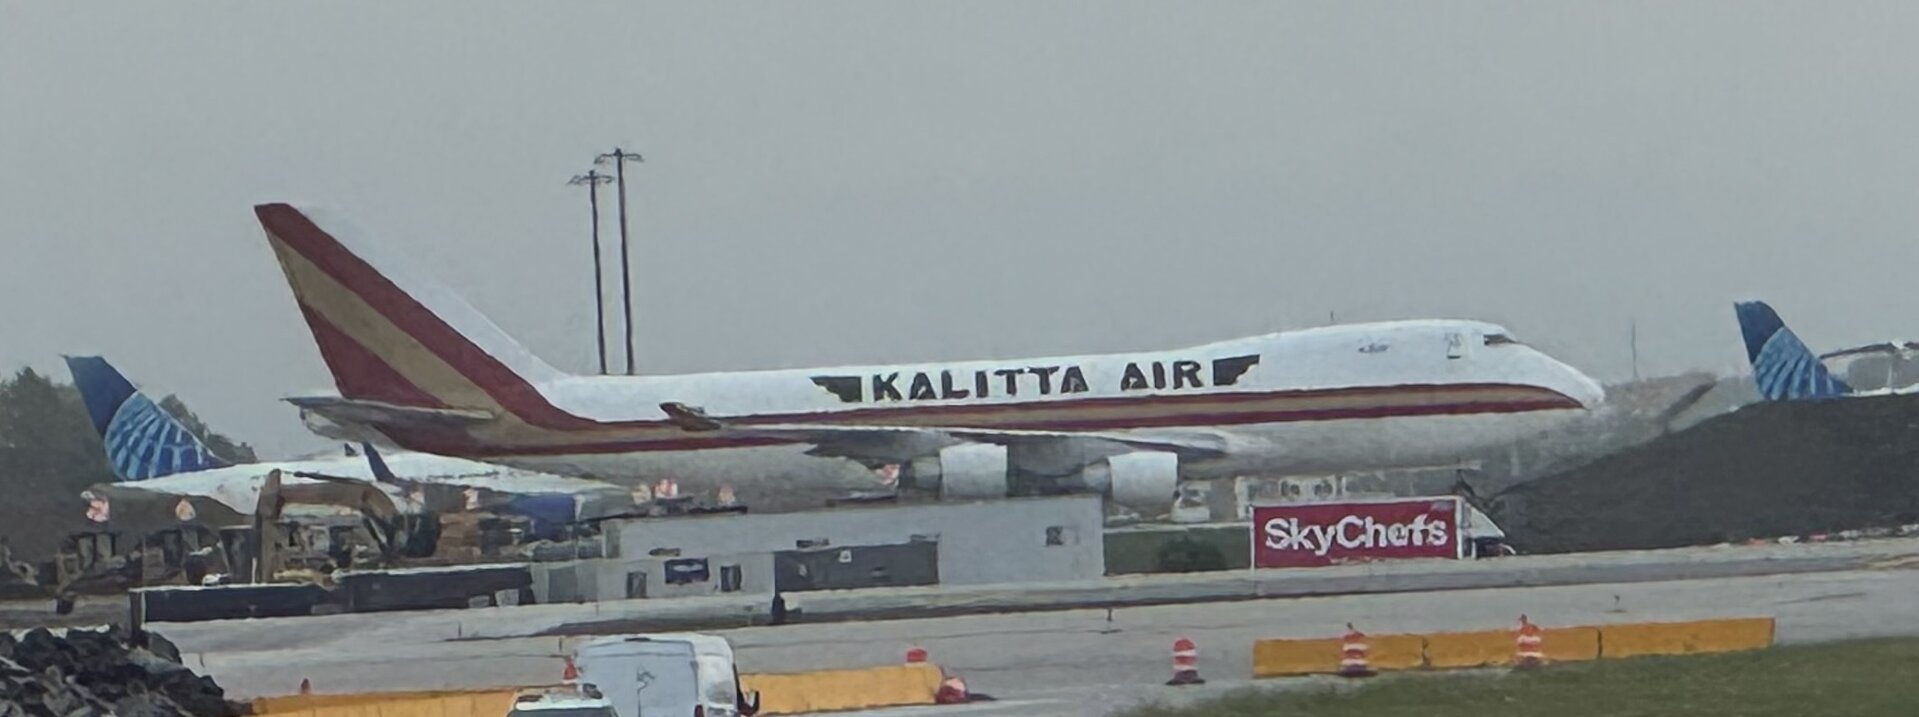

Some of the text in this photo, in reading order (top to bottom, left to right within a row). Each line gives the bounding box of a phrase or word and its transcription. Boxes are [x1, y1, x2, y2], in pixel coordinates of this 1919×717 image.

[873, 360, 1204, 402] KALITTA AIR
[1264, 514, 1449, 556] SkyChefs
